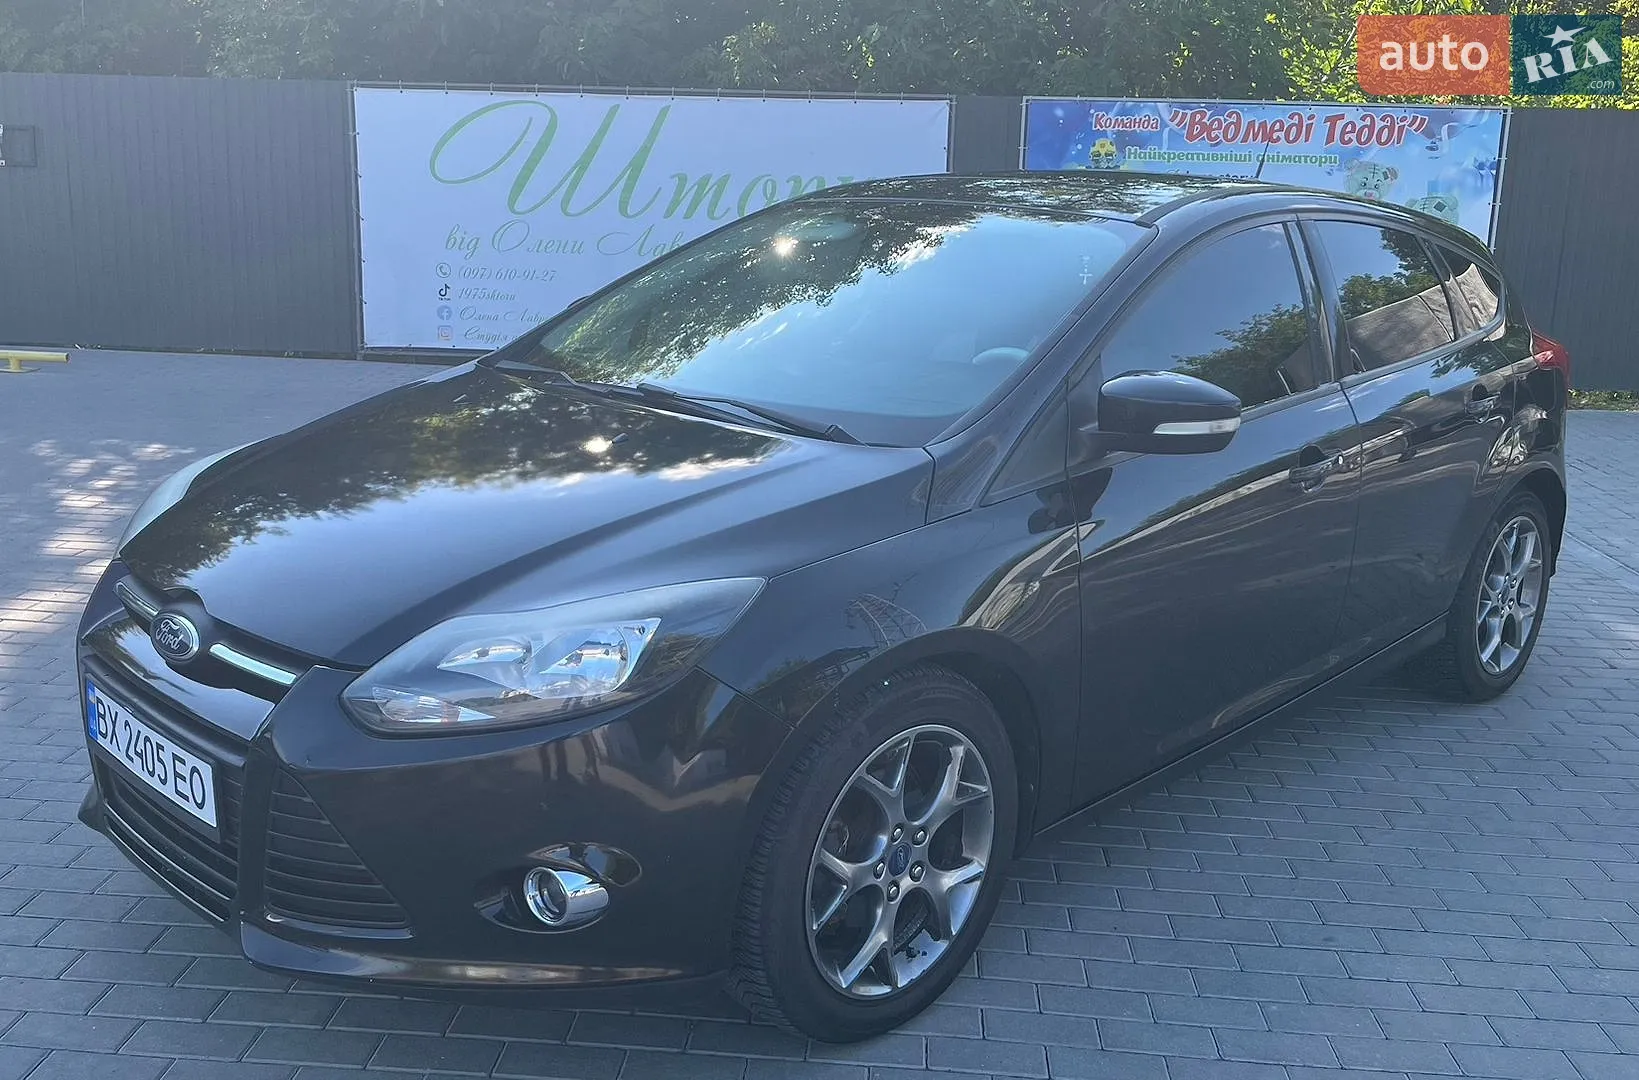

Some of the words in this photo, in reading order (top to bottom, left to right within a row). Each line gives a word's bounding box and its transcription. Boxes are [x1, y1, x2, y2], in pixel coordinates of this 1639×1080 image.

[1094, 112, 1160, 130] Команда
[1126, 147, 1253, 163] Найкреативніші
[1256, 152, 1339, 167] аніматори
[445, 223, 480, 259] від
[491, 219, 585, 254] Олени
[458, 266, 492, 281] (097)
[495, 268, 557, 282] 610-91-27
[459, 305, 499, 321] Олена
[155, 618, 184, 651] Ford
[95, 696, 121, 752] BX
[124, 717, 168, 786] 2405
[172, 754, 206, 810] EO
